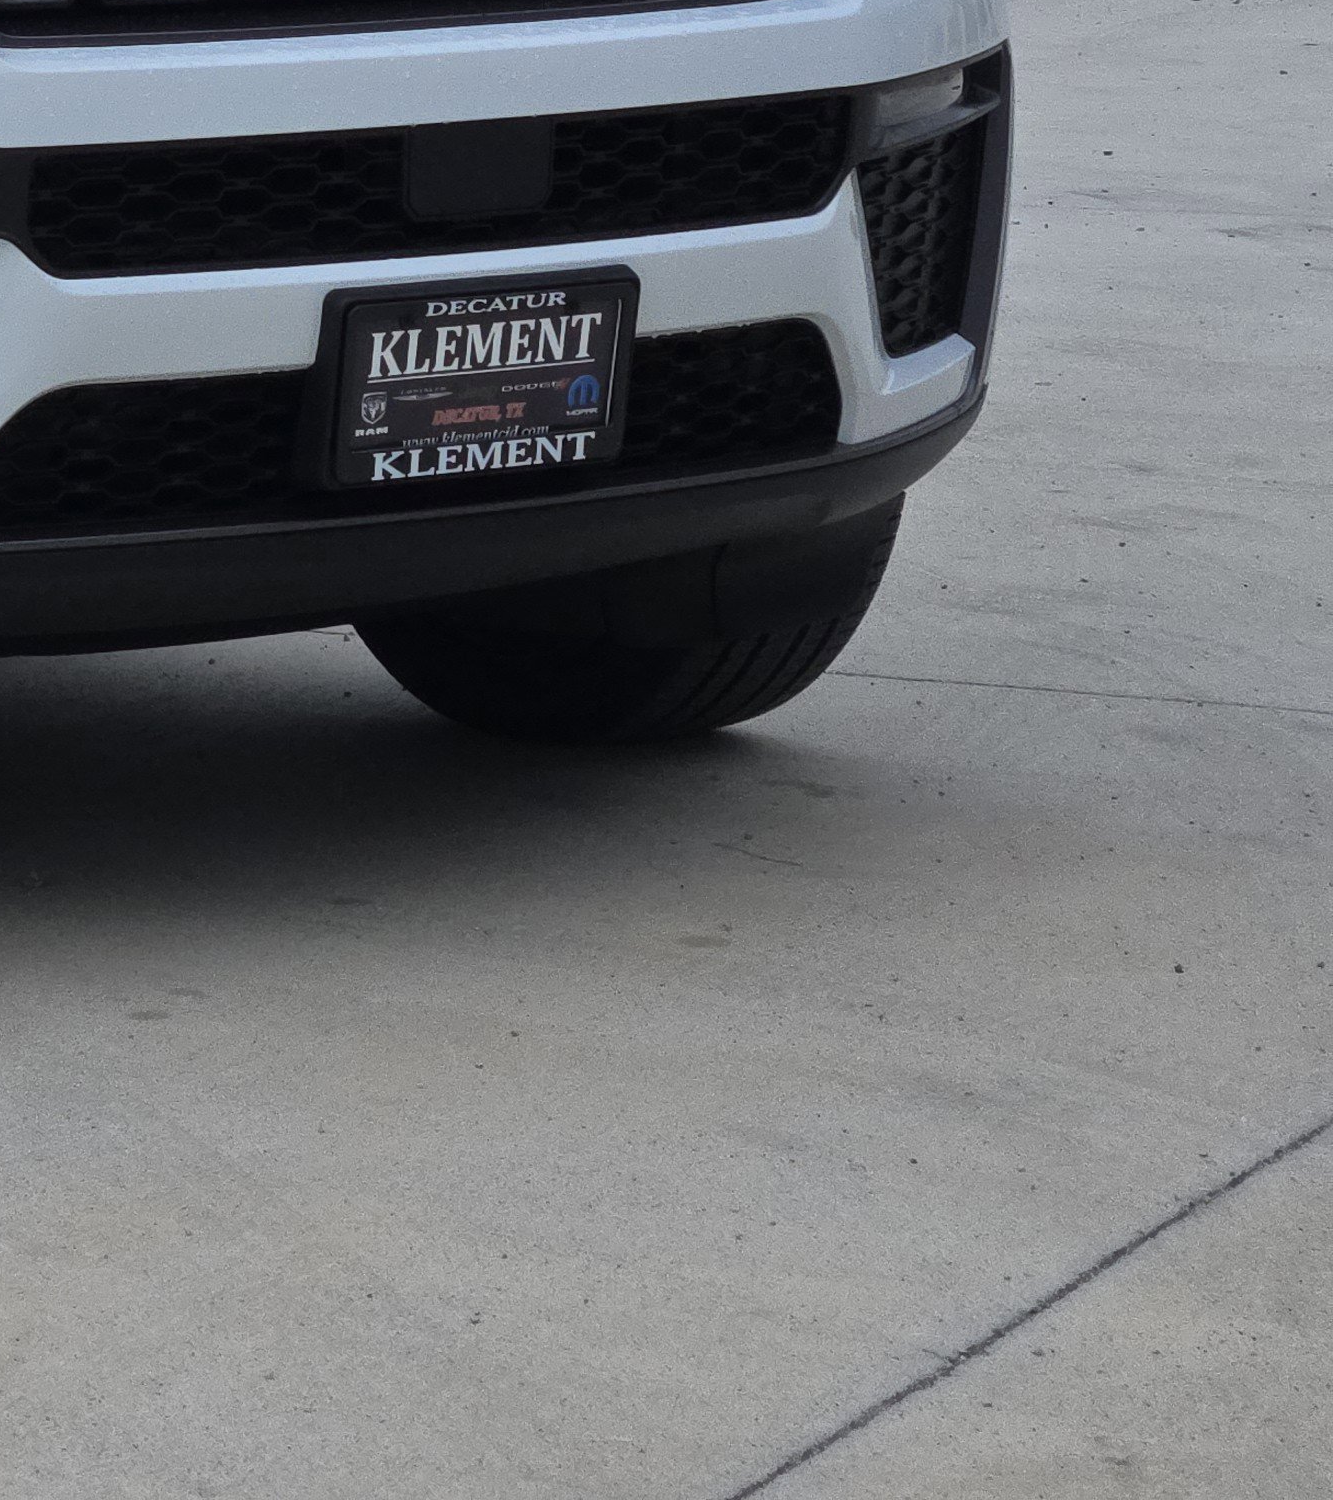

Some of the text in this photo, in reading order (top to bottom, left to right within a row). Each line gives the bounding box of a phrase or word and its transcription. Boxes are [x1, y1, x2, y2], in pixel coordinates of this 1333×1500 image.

[425, 291, 567, 318] DECATUR
[367, 312, 603, 379] KLEMENT
[355, 426, 389, 437] RAM
[371, 431, 596, 482] KLEMENT
